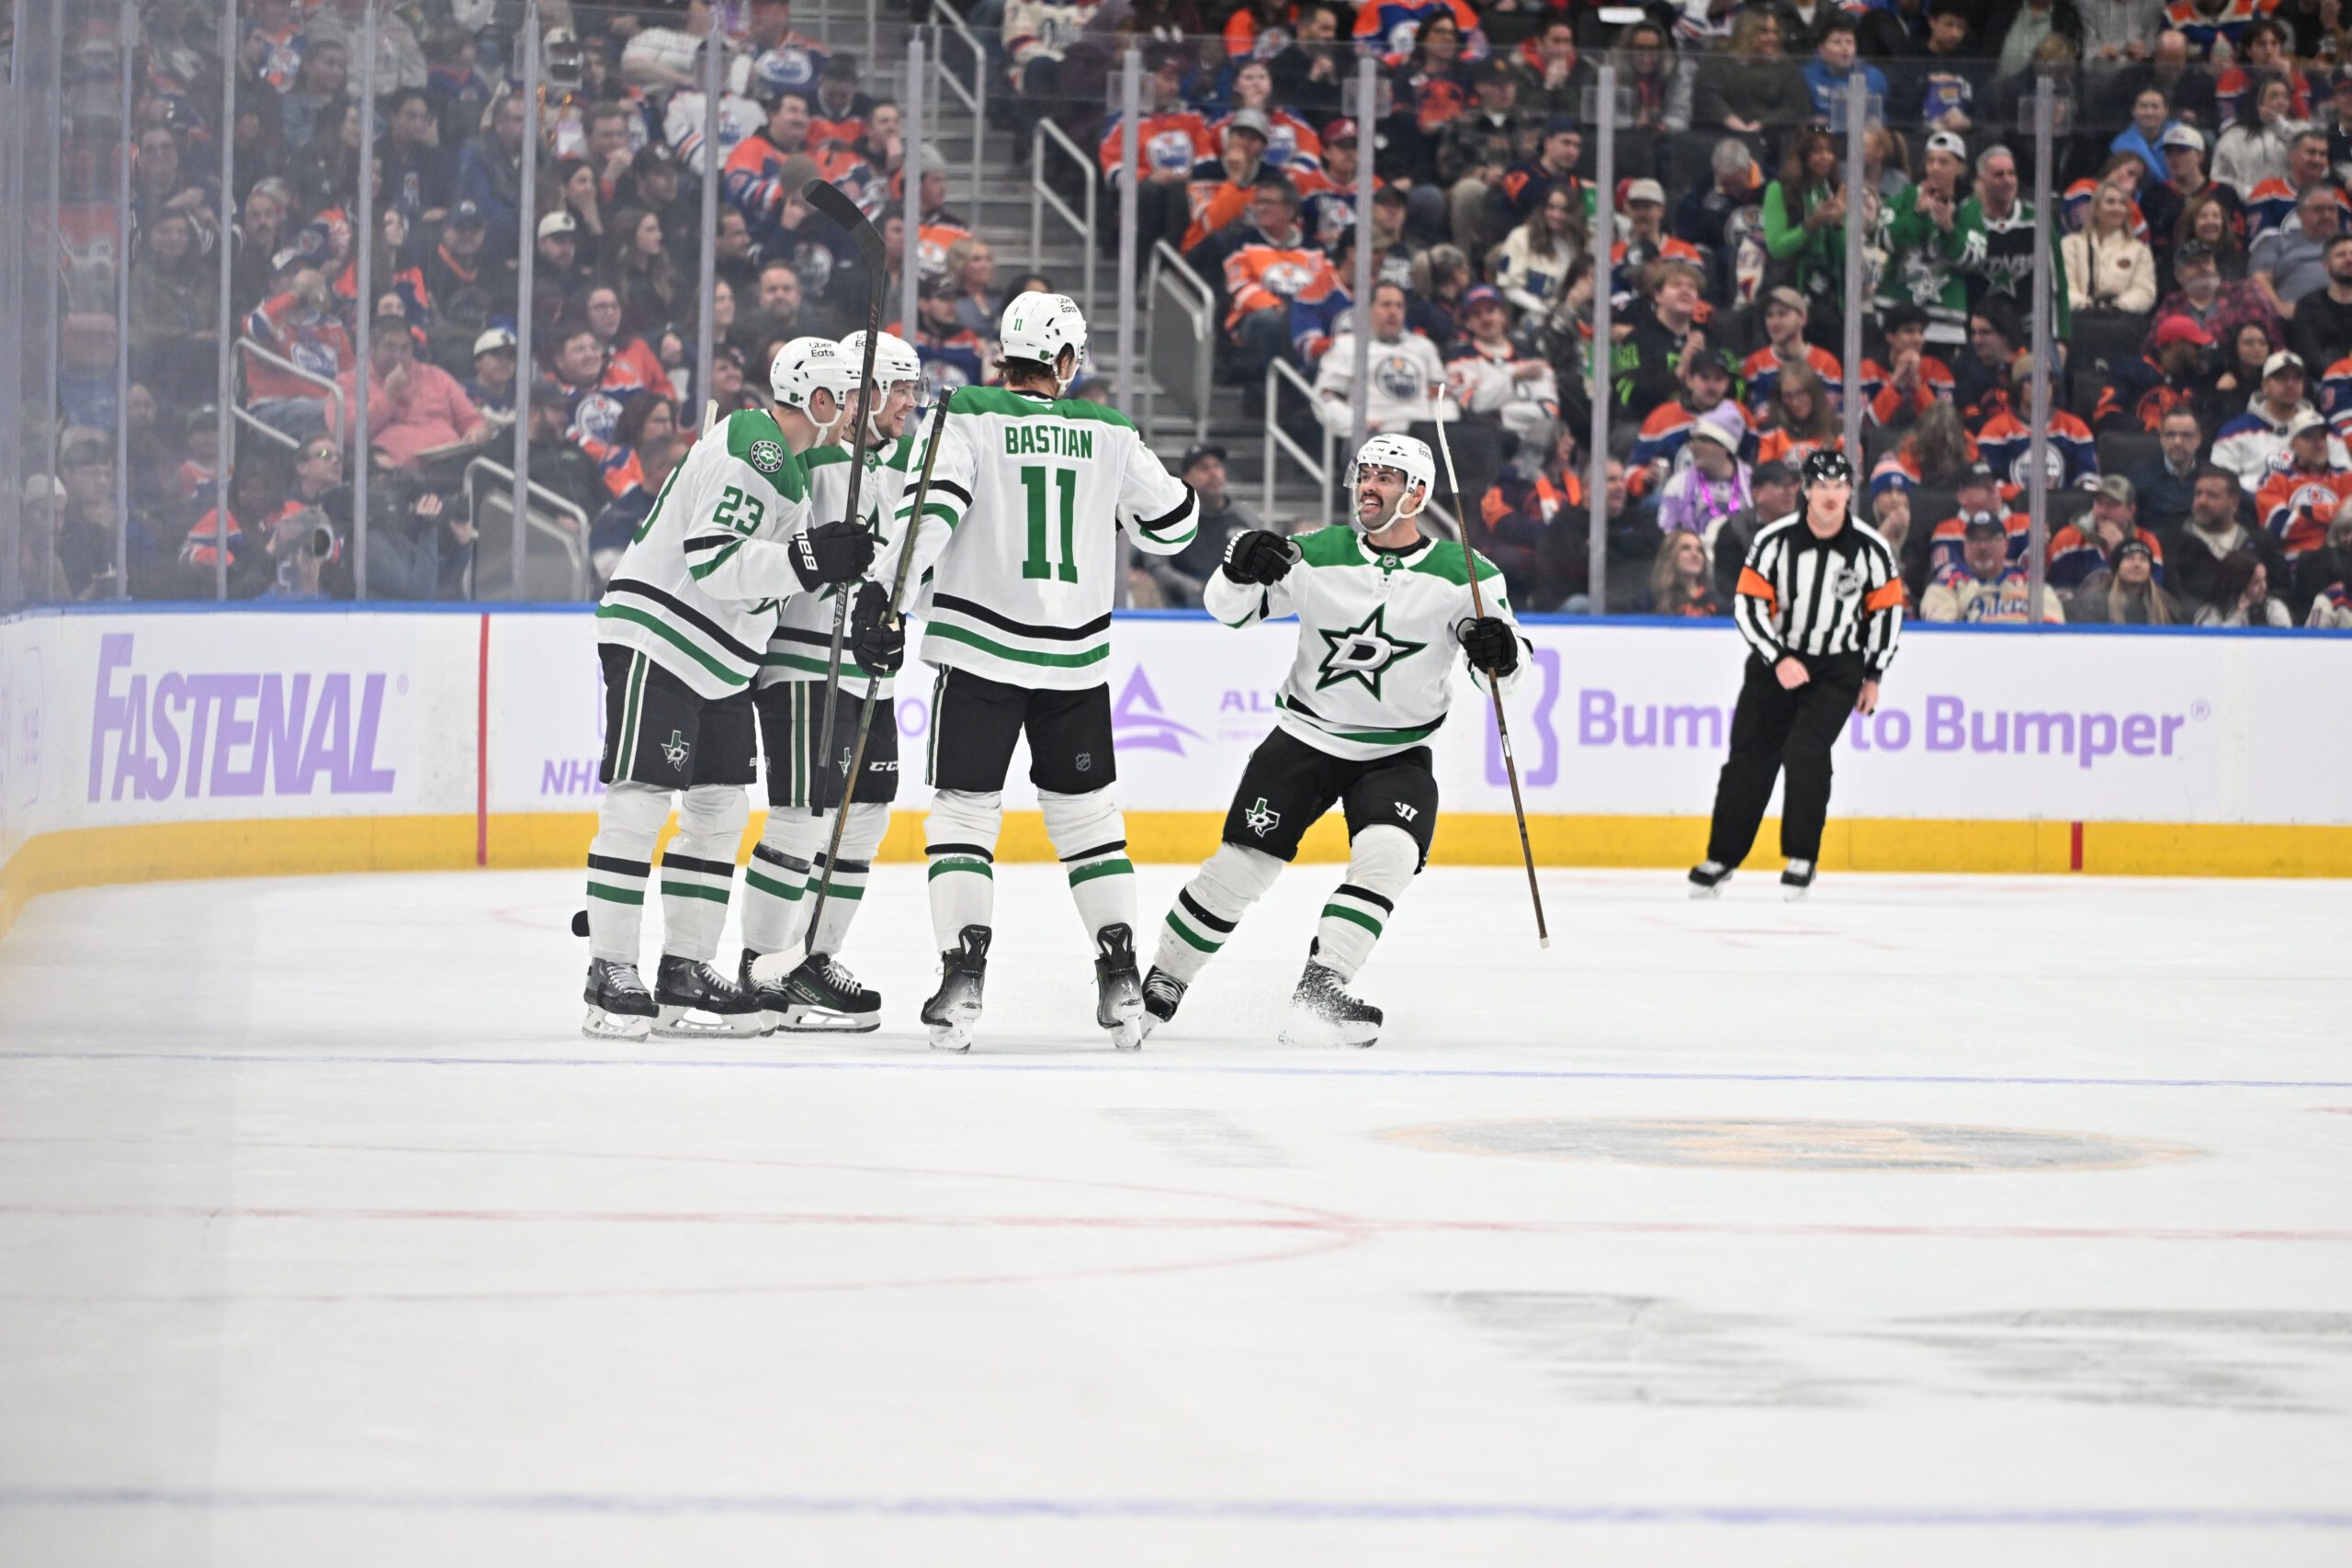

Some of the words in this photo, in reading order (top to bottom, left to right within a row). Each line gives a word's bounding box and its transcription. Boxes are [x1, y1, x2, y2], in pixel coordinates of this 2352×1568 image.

[1013, 318, 1023, 331] 11
[811, 349, 835, 357] Eats
[1004, 425, 1092, 459] BASTIAN
[712, 485, 764, 536] 23
[1021, 466, 1079, 584] 11
[87, 633, 396, 803] FASTENAL
[1578, 689, 1735, 749] Bum
[1849, 704, 1911, 751] to
[1926, 694, 2185, 768] Bumper
[869, 761, 899, 772] CC
[792, 979, 821, 1002] CCM
